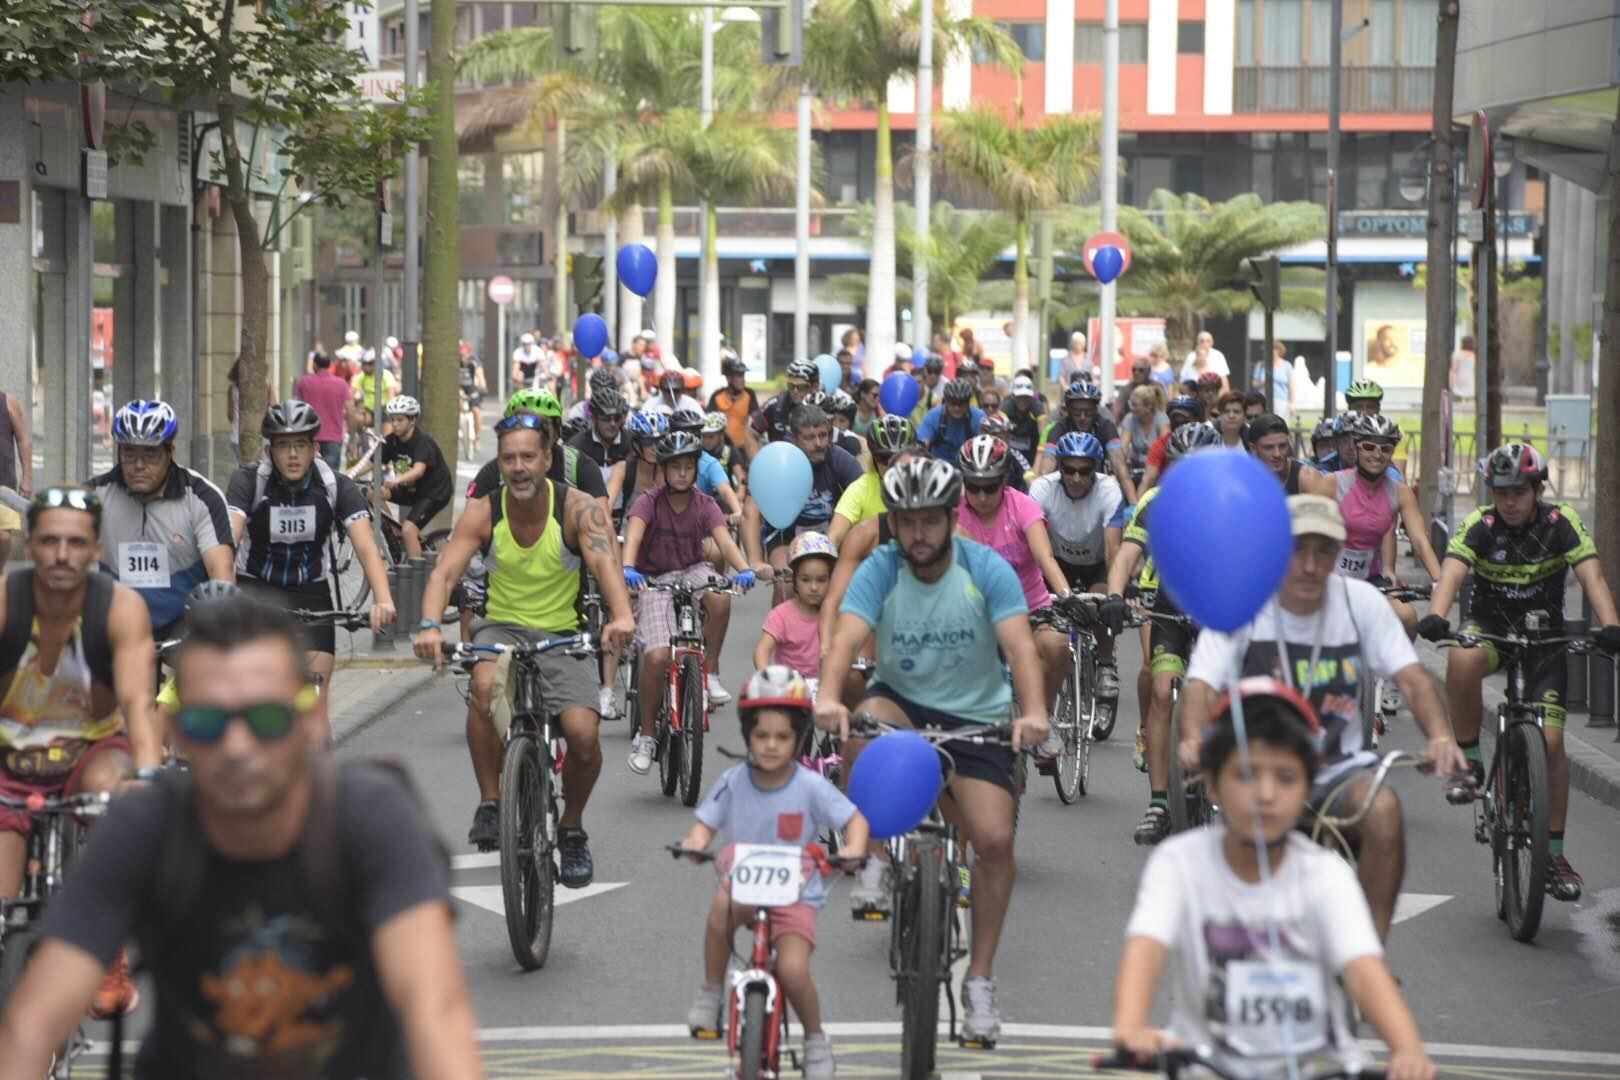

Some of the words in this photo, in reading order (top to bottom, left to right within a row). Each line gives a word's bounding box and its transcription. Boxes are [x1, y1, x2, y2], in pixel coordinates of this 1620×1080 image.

[279, 519, 306, 534] 3113
[128, 556, 160, 572] 3114
[736, 865, 791, 886] 0779
